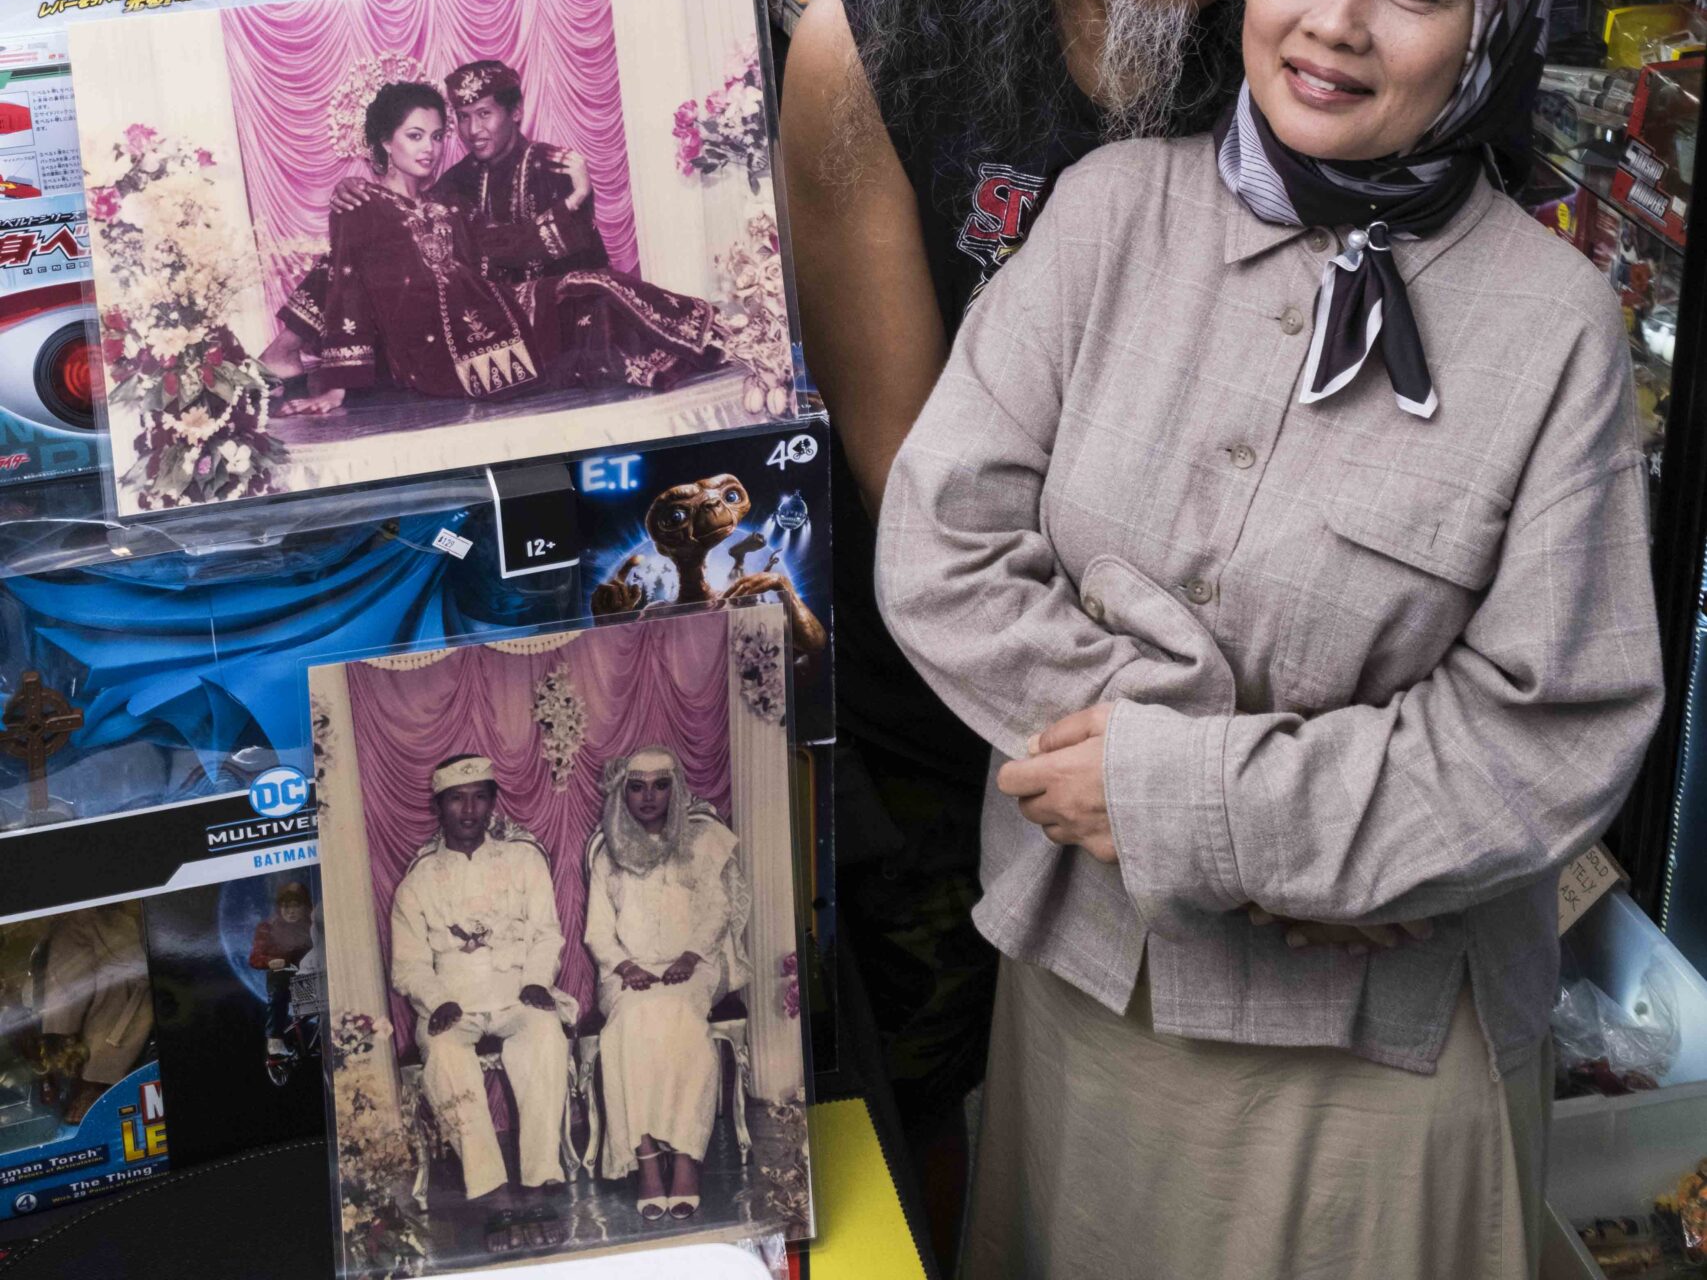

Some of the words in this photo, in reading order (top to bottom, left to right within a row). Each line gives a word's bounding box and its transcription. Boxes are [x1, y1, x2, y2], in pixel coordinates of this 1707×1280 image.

[582, 454, 641, 493] E.T.
[526, 538, 556, 558] 12+
[253, 776, 308, 811] DC
[253, 844, 318, 869] BATMAN
[1586, 850, 1609, 877] SOLD
[1561, 884, 1581, 912] ASK
[49, 1149, 97, 1167] Torch
[70, 1180, 100, 1192] The
[106, 1166, 152, 1183] Thing
